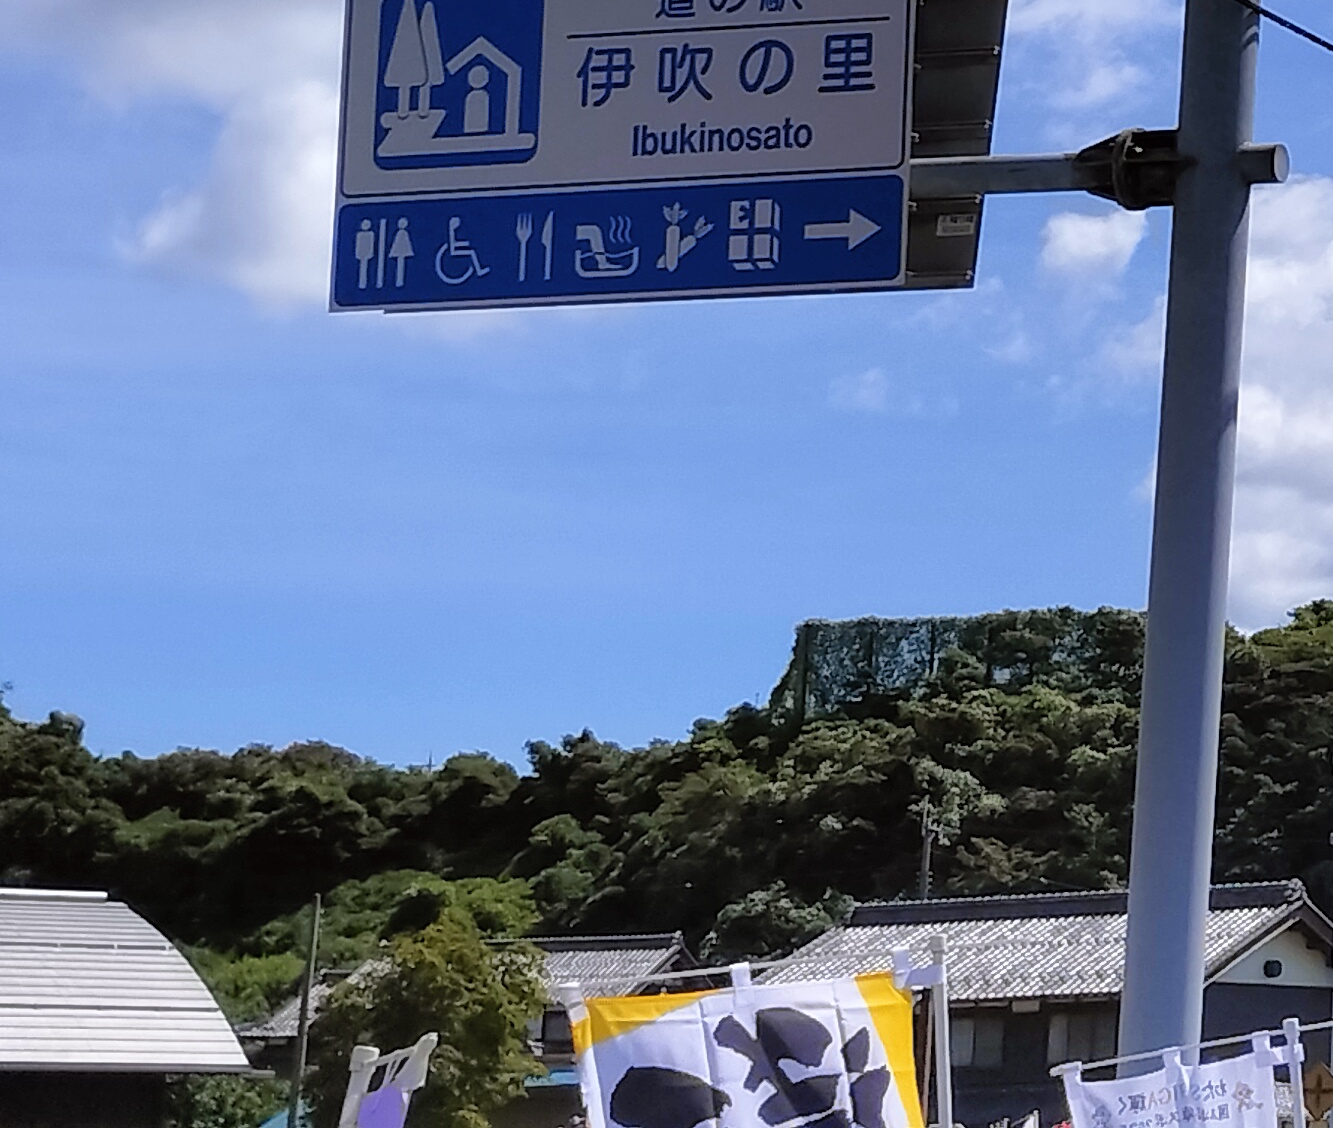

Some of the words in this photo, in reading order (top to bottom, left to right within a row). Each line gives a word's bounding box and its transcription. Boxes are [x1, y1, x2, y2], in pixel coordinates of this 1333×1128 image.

[576, 32, 876, 107] 伊吹の里
[632, 117, 812, 157] Ibukinosato
